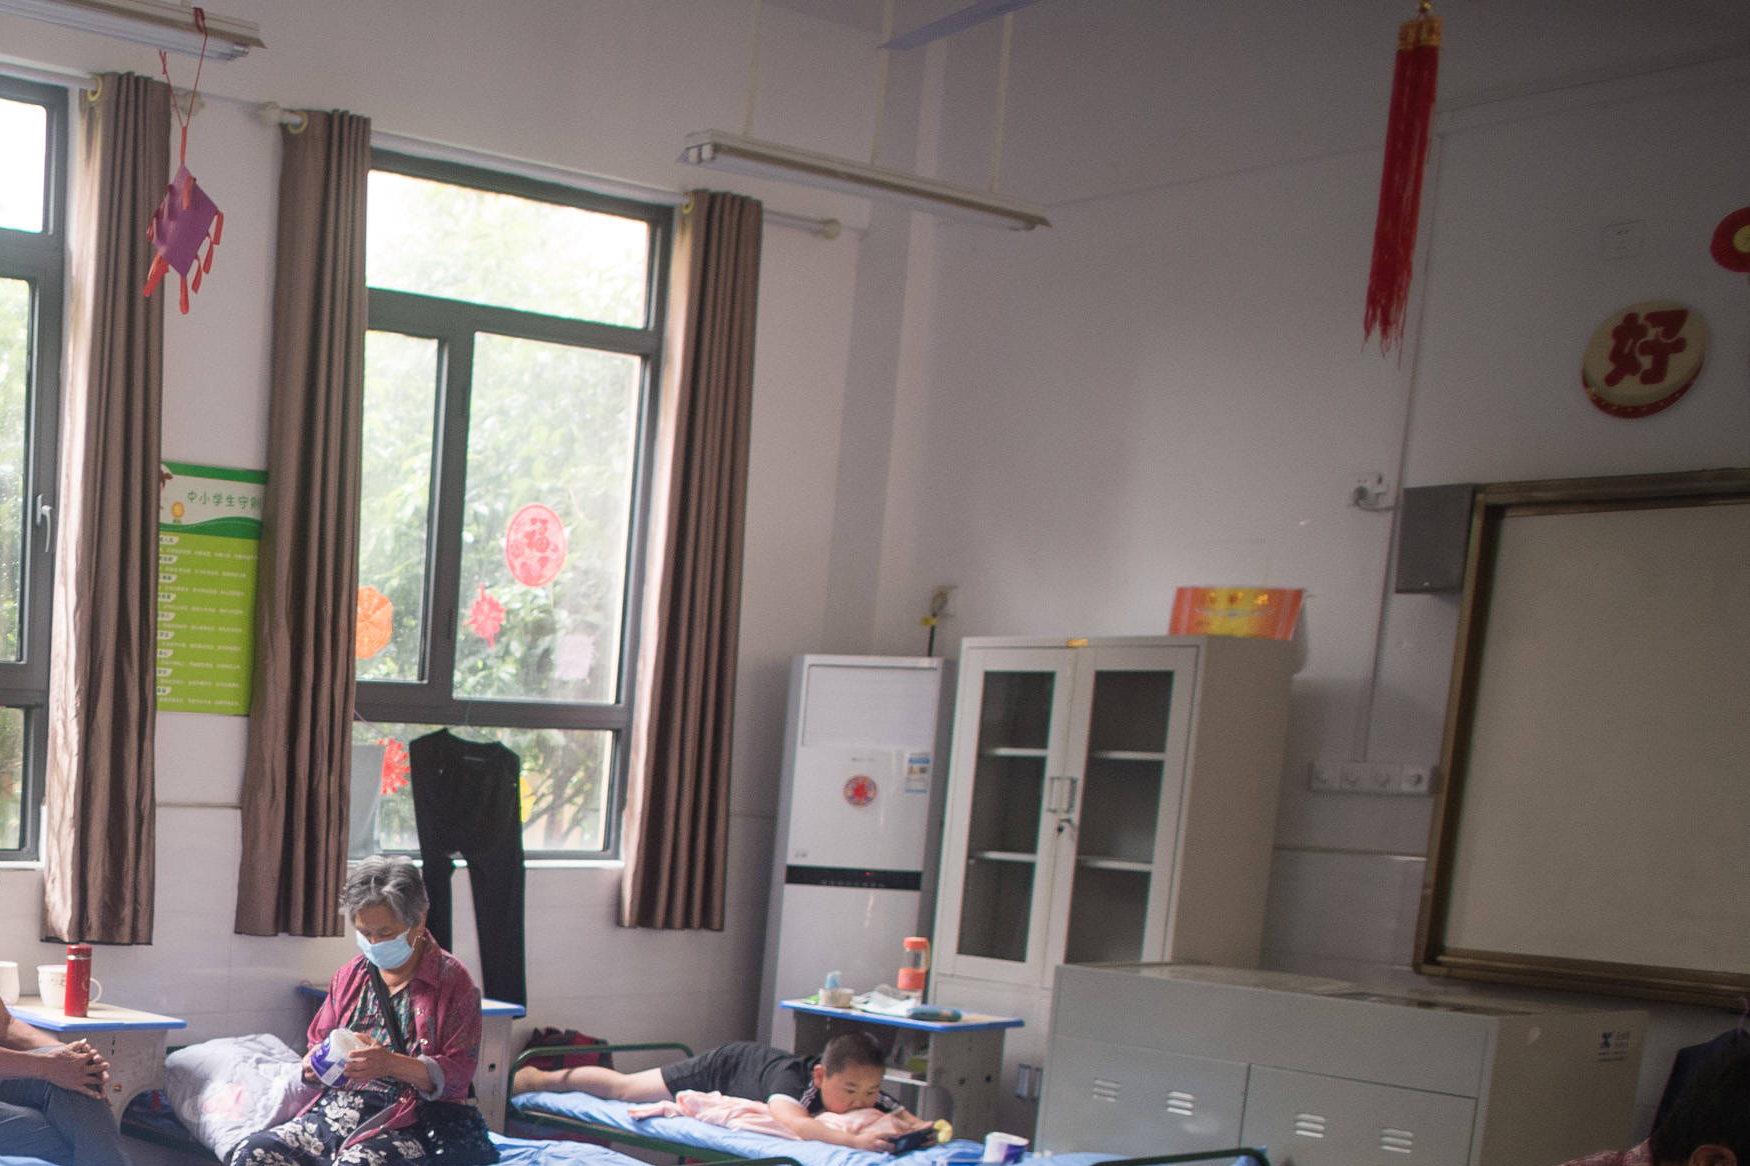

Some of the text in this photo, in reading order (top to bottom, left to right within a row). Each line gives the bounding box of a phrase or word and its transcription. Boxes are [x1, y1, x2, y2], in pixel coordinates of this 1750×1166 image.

[1605, 309, 1688, 386] 好
[187, 490, 262, 511] 中小学生守则
